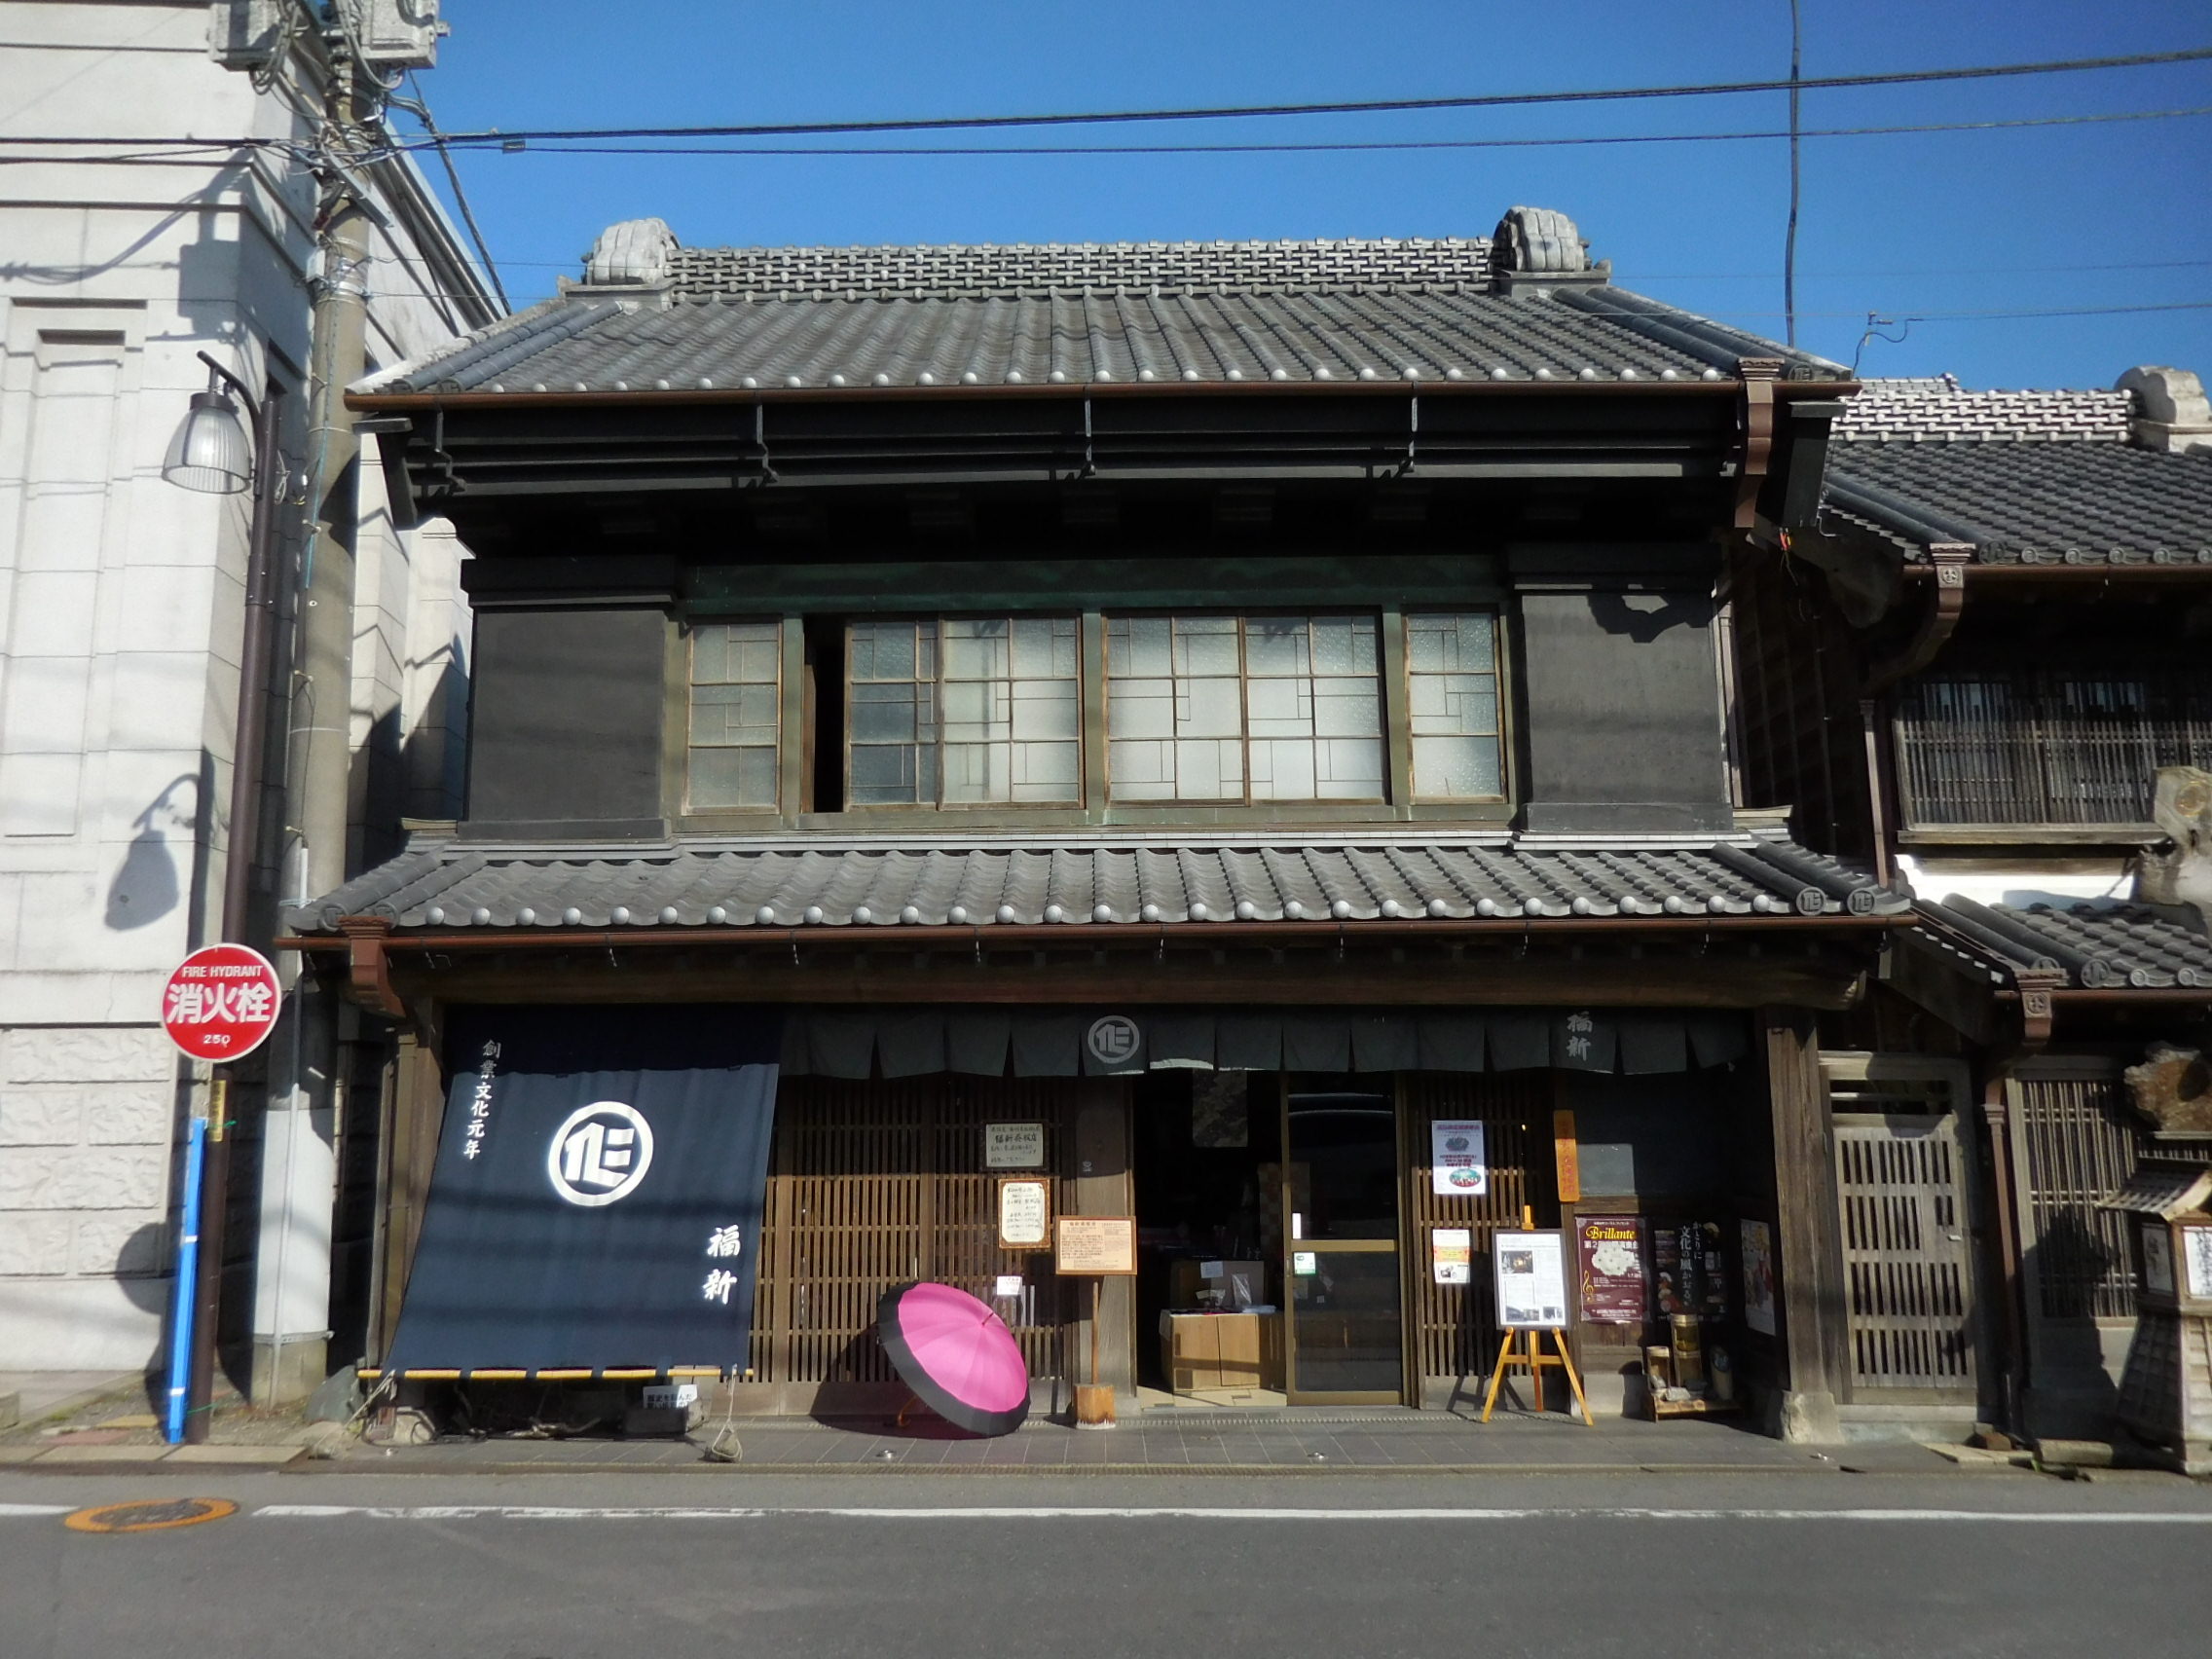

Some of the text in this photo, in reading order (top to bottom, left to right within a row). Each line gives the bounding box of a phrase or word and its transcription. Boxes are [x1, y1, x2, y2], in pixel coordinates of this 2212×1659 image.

[181, 964, 264, 977] FIRE HYDRANT
[166, 981, 273, 1024] 消火栓
[203, 1034, 232, 1045] 250
[1566, 1011, 1593, 1061] 福新
[463, 1039, 502, 1161] 創業文化元年
[1585, 1225, 1636, 1240] Brillante
[701, 1224, 741, 1306] 福新
